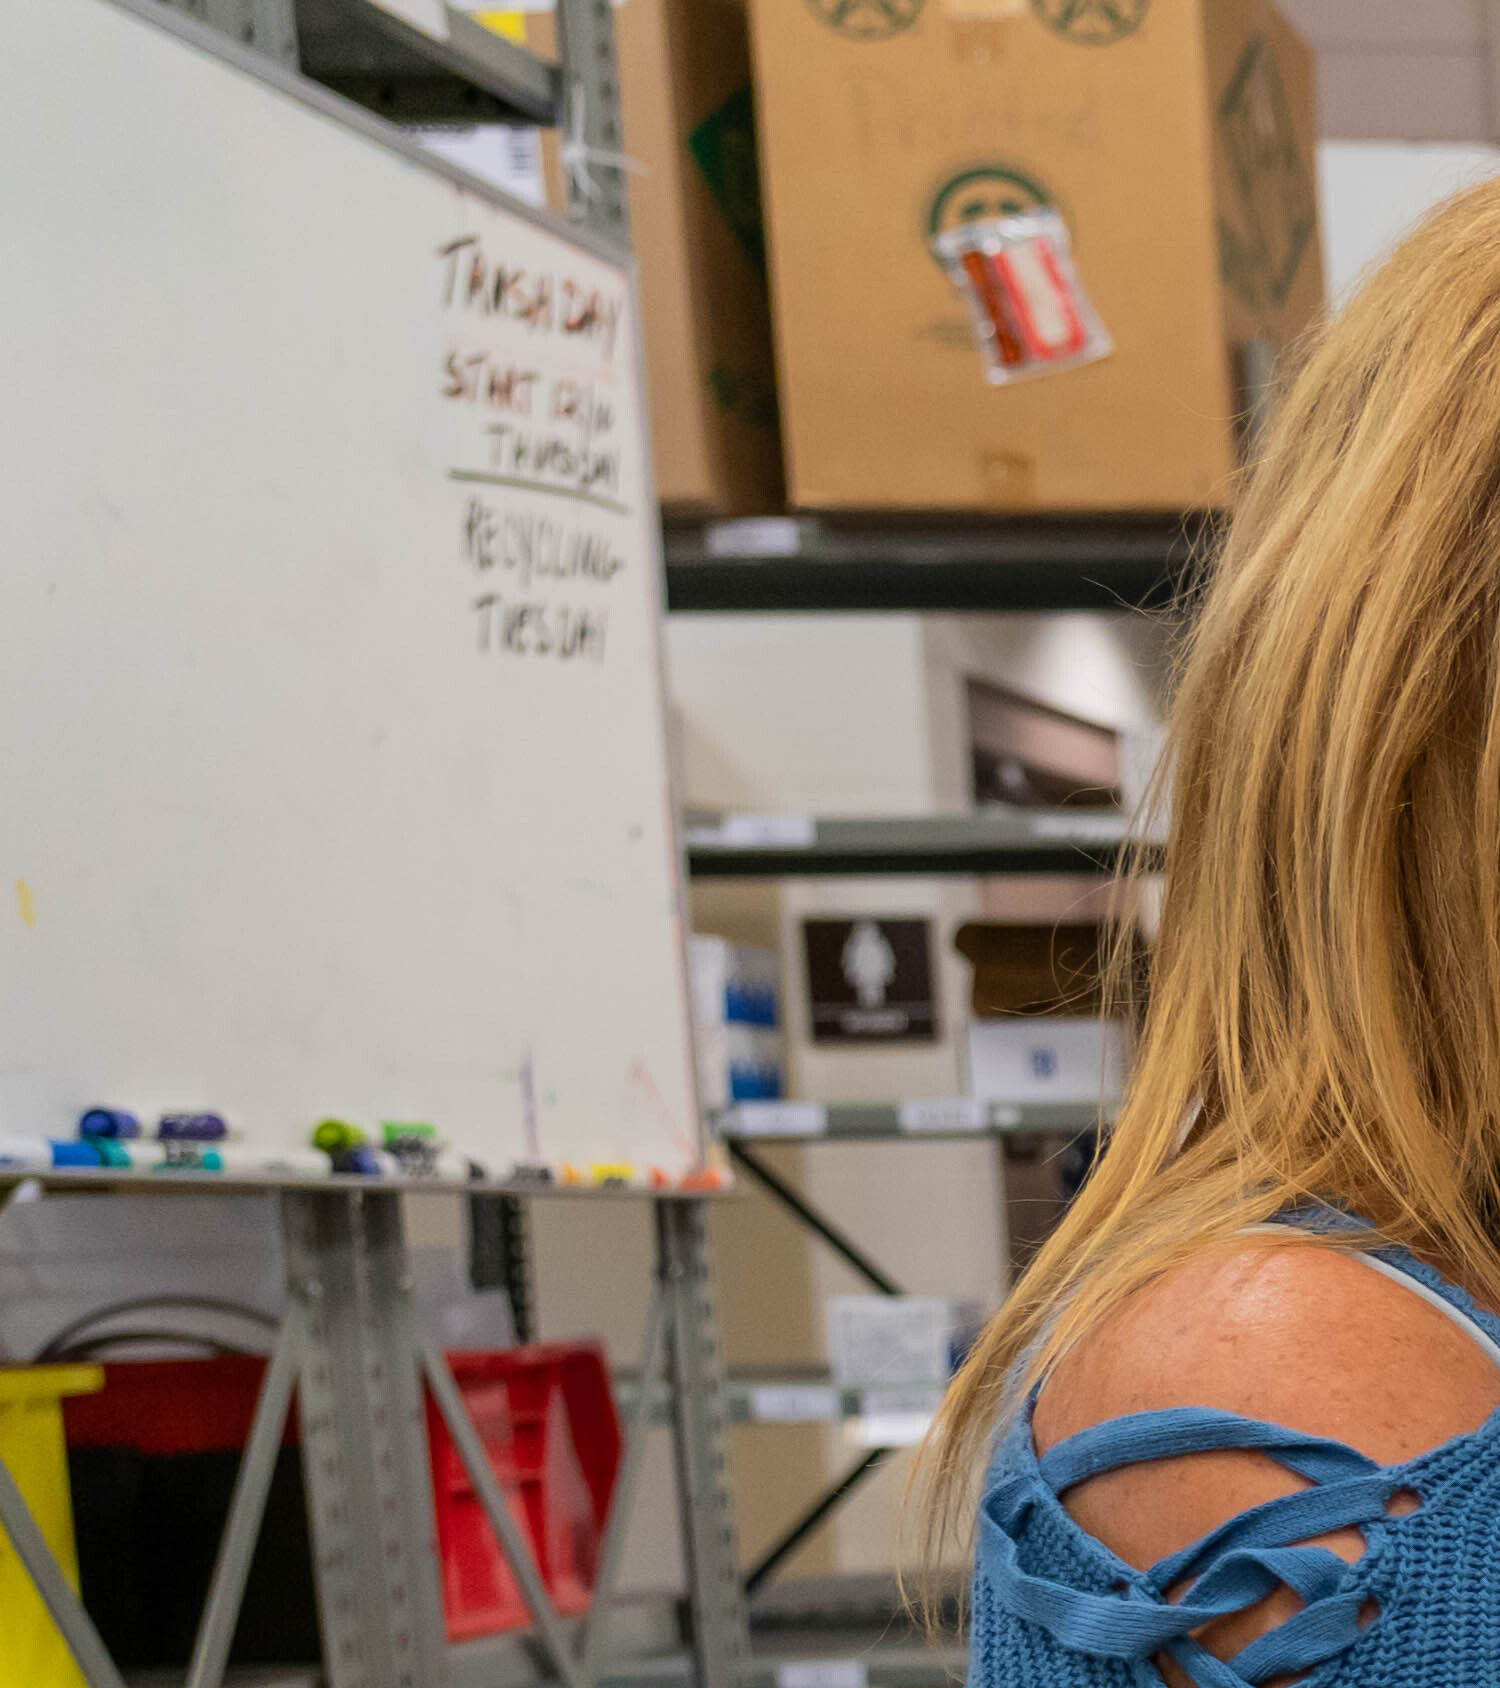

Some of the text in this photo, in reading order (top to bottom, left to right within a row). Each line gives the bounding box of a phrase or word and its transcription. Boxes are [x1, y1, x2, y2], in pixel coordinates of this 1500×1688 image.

[434, 232, 622, 360] TRASH DAY
[463, 497, 624, 590] RECYCLING
[472, 592, 608, 666] TUESDAY
